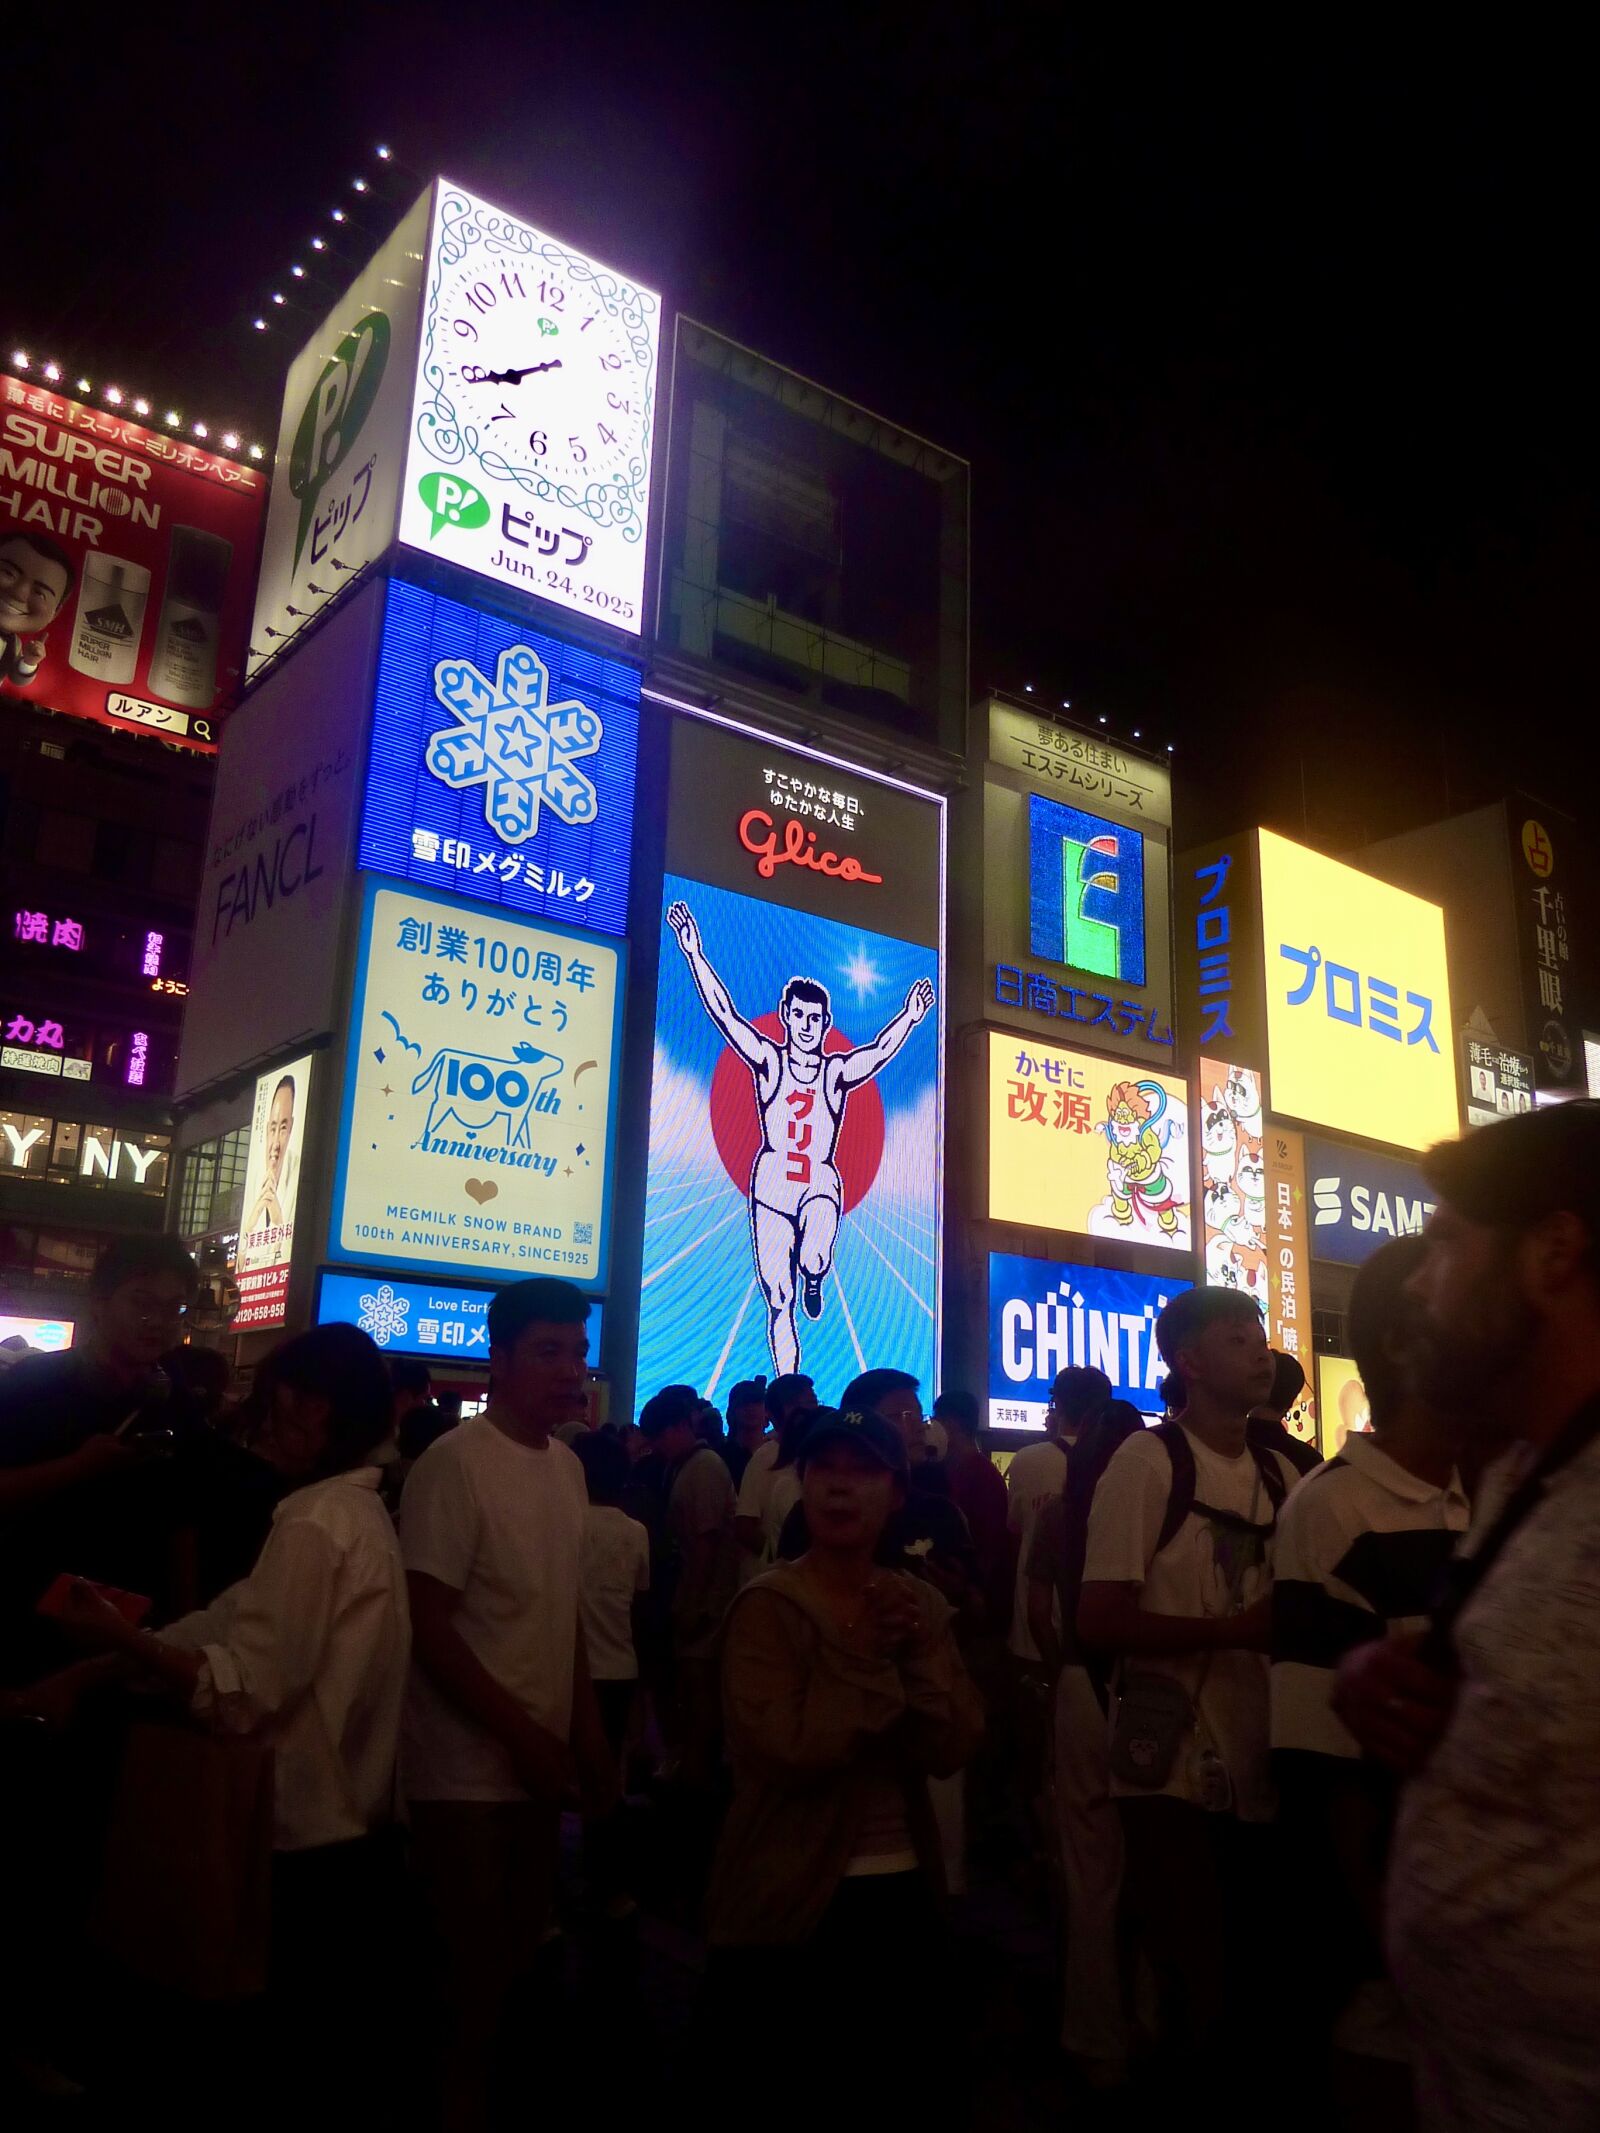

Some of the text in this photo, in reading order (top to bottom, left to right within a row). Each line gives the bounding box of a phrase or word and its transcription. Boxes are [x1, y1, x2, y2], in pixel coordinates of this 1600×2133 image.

[465, 281, 498, 315] 10
[500, 272, 527, 299] 11
[537, 281, 566, 312] 12
[453, 319, 478, 342] 9
[599, 353, 622, 371] 2
[491, 403, 517, 424] 7
[607, 391, 630, 414] 3
[2, 413, 152, 491] SUPER
[529, 430, 548, 457] 6
[568, 436, 588, 463] 5
[597, 421, 618, 447] 4
[0, 448, 162, 530] MILLION
[310, 453, 377, 565] ピップ
[501, 503, 593, 567] ピップ
[491, 550, 634, 620] Jun. 24, 2025
[115, 699, 172, 724] ルアン
[1037, 723, 1128, 774] 夢ある住まい
[762, 768, 865, 816] すこやかな毎日、
[1021, 749, 1144, 811] エステムシリーズ
[770, 790, 855, 832] ゆたかな人生
[412, 828, 595, 902] 雪印メグミルク
[739, 809, 882, 885] Glico
[1526, 821, 1550, 871] 占
[212, 813, 324, 947] FANCL
[15, 909, 84, 951] 焼肉
[1195, 854, 1235, 1045] プロミス
[1530, 885, 1564, 1017] 千里眼
[397, 916, 596, 994] 創業100周年
[151, 978, 190, 996] ようこ
[422, 971, 568, 1032] ありがとう
[994, 962, 1175, 1047] 日商エステム
[1279, 943, 1441, 1055] プロミス
[5, 1014, 64, 1049] 力丸
[1015, 1050, 1085, 1089] かぜに
[1006, 1079, 1092, 1135] 改源
[410, 1130, 558, 1178] Anniversary
[785, 1087, 816, 1184] グリコ
[82, 1136, 162, 1184] NY
[247, 1222, 293, 1249] 東京美容外科
[354, 1224, 394, 1242] 100th
[387, 1205, 562, 1241] MEGMILK SNOW BRAND
[1276, 1181, 1300, 1361] 日本一の民泊「暁
[236, 1302, 286, 1325] 0120-658-958
[428, 1297, 491, 1315] Love Eart
[417, 1318, 491, 1349] 雪印メ
[996, 1407, 1028, 1424] 天気予報
